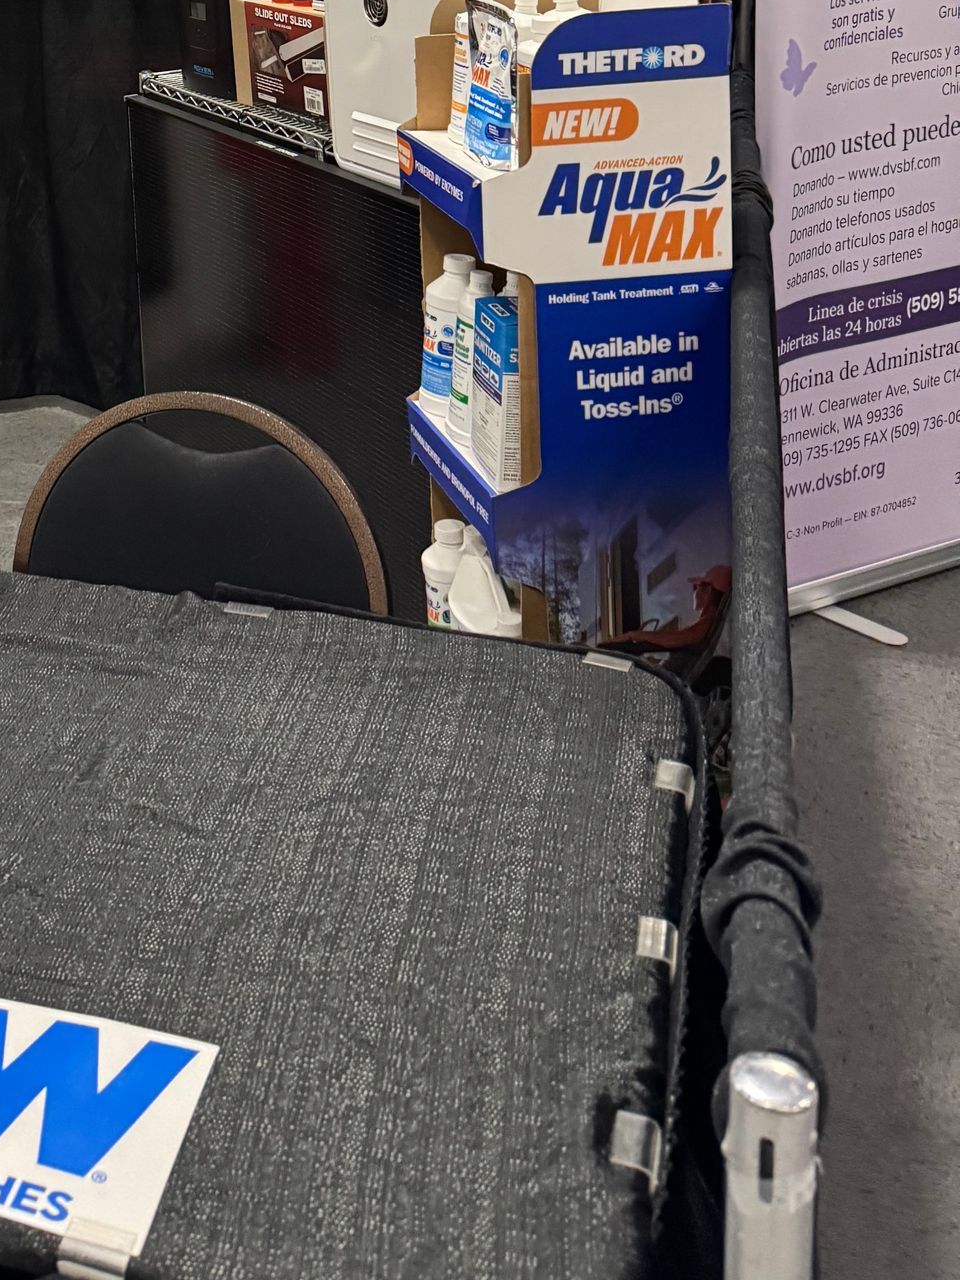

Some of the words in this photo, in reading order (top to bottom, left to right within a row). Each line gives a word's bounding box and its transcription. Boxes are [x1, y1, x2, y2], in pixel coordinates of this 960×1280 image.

[254, 7, 273, 20] SLIDE
[274, 12, 288, 23] OUT
[289, 15, 312, 28] SLEDS
[832, 16, 849, 29] son
[852, 8, 884, 28] gratis
[888, 8, 895, 23] y
[824, 26, 903, 51] confidenciales
[891, 48, 942, 64] Recursos
[945, 46, 951, 60] y
[826, 78, 870, 96] Servicios
[873, 74, 888, 87] de
[892, 65, 952, 87] prevencion
[543, 107, 621, 140] NEW!
[791, 141, 836, 170] Como
[841, 123, 896, 155] usted
[902, 114, 960, 151] puede
[594, 155, 683, 171] ADVANCED-ACTION
[793, 173, 835, 197] Donando
[848, 156, 941, 181] www.dvsbf.com
[538, 163, 686, 244] Aqua
[791, 196, 833, 220] Donando
[837, 193, 849, 206] su
[853, 186, 895, 204] tiempo
[602, 207, 723, 266] MAX
[790, 219, 832, 244] Donando
[836, 209, 891, 229] telefonos
[895, 200, 935, 218] usados
[788, 242, 831, 267] Donando
[835, 232, 885, 252] artículos
[889, 228, 915, 245] para
[918, 221, 928, 236] el
[931, 218, 960, 234] hoga
[786, 267, 828, 290] sabanas,
[832, 260, 859, 275] ollas
[862, 258, 870, 273] y
[873, 247, 923, 267] sartenes
[548, 292, 589, 306] Holding
[592, 290, 617, 301] Tank
[619, 286, 673, 299] Treatment
[808, 304, 844, 323] Linea
[848, 296, 865, 314] de
[867, 289, 903, 310] crisis
[906, 291, 944, 319] (509)
[822, 325, 841, 341] las
[845, 321, 862, 337] 24
[865, 313, 902, 333] horas
[568, 334, 671, 361] Available
[678, 332, 699, 352] in
[576, 365, 644, 392] Liquid
[651, 361, 693, 382] and
[779, 369, 834, 396] Oficina
[840, 361, 859, 381] de
[801, 402, 815, 418] W.
[819, 390, 882, 414] Clearwater
[885, 384, 909, 399] Ave,
[913, 375, 940, 392] Suite
[782, 421, 840, 445] ennewick,
[843, 415, 863, 430] WA
[867, 404, 903, 424] 99336
[806, 436, 860, 462] 735-1295
[864, 430, 887, 447] FAX
[890, 419, 920, 444] (509)
[785, 459, 885, 499] ww.dvsbf.org
[476, 501, 489, 525] FREE
